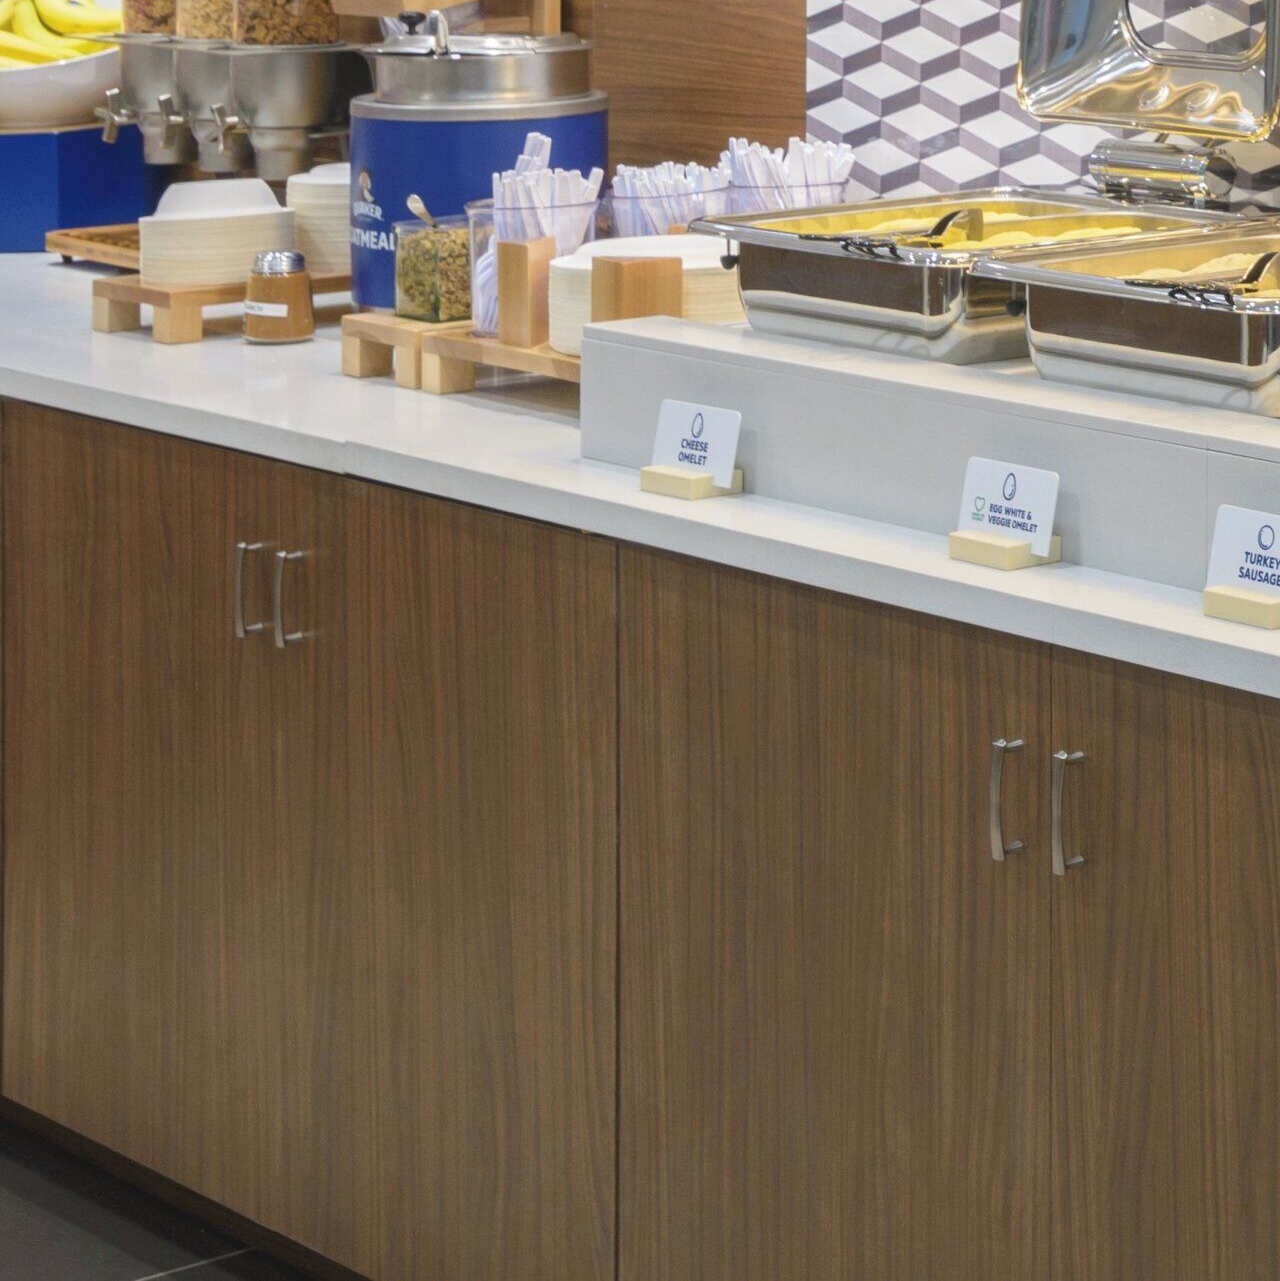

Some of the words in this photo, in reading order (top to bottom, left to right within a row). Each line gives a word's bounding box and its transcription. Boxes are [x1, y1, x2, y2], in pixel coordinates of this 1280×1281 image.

[350, 226, 395, 251] ATMEAL
[681, 439, 709, 453] CHEESE
[678, 451, 707, 466] OMELET
[989, 503, 1003, 514] EGG
[1004, 506, 1026, 519] WHITE
[1027, 511, 1032, 520] &
[988, 515, 1012, 529] VEGGIE
[1012, 520, 1038, 533] OMELET
